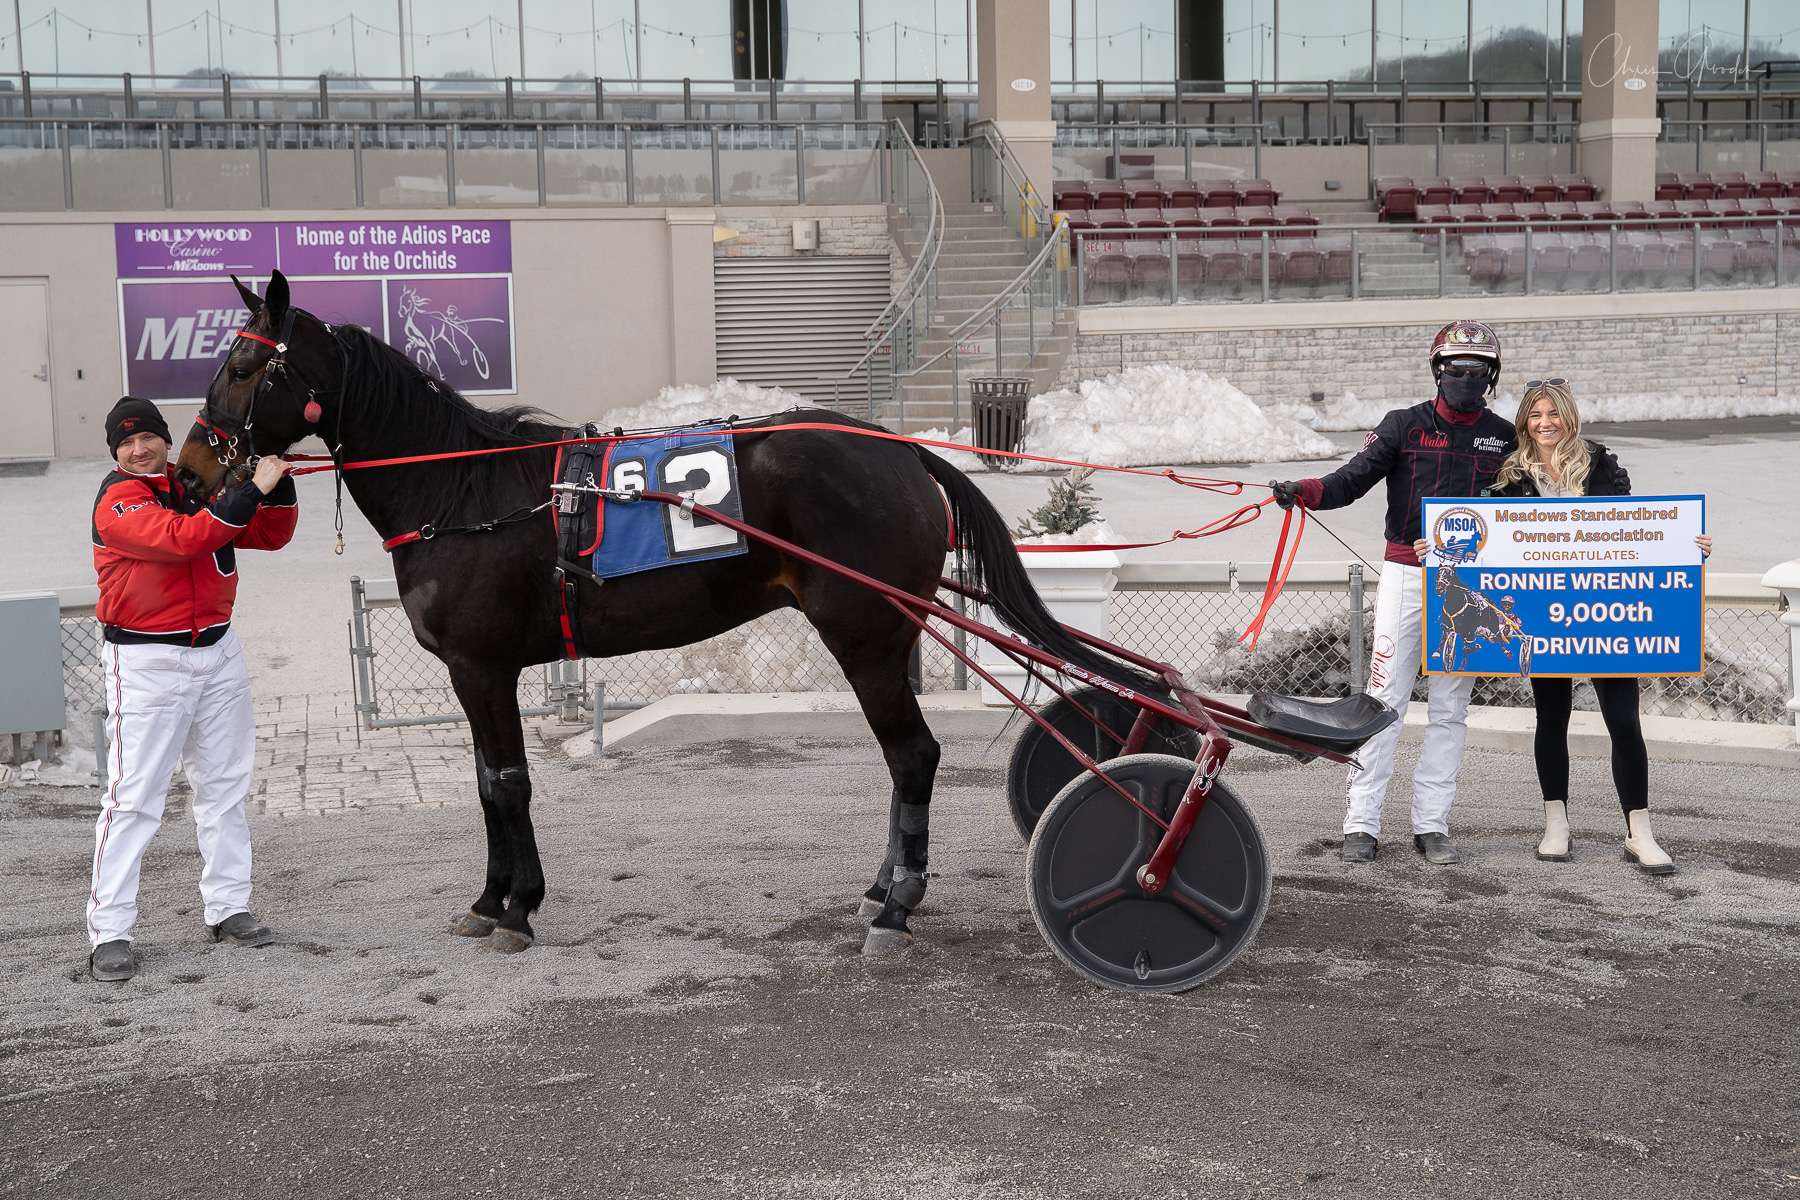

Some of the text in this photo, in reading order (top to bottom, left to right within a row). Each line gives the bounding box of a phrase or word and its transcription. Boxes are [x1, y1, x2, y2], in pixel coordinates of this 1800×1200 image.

[135, 228, 253, 242] HOLLYWOOD
[296, 225, 491, 246] Home of the Adios Pace
[164, 238, 221, 257] Casino
[1085, 242, 1112, 252] SEC 14
[173, 260, 225, 272] MEADOWS
[334, 250, 457, 271] for the Orchids
[195, 308, 251, 327] THE
[960, 344, 971, 355] SEC
[1407, 427, 1450, 448] Walsh
[1473, 437, 1509, 448] grattan
[1478, 445, 1502, 453] helmets
[613, 460, 645, 500] 6
[664, 450, 738, 553] 2
[1495, 507, 1678, 522] Meadows Standardbred
[1444, 518, 1477, 532] MSOA
[1512, 528, 1664, 542] Owners Association
[1522, 550, 1639, 561] CONGRATULATES:
[1479, 571, 1694, 590] RONNIE WRENN JR.
[1548, 601, 1653, 627] 9,000th
[1533, 636, 1680, 655] DRIVING WIN
[1371, 635, 1395, 689] Walsh
